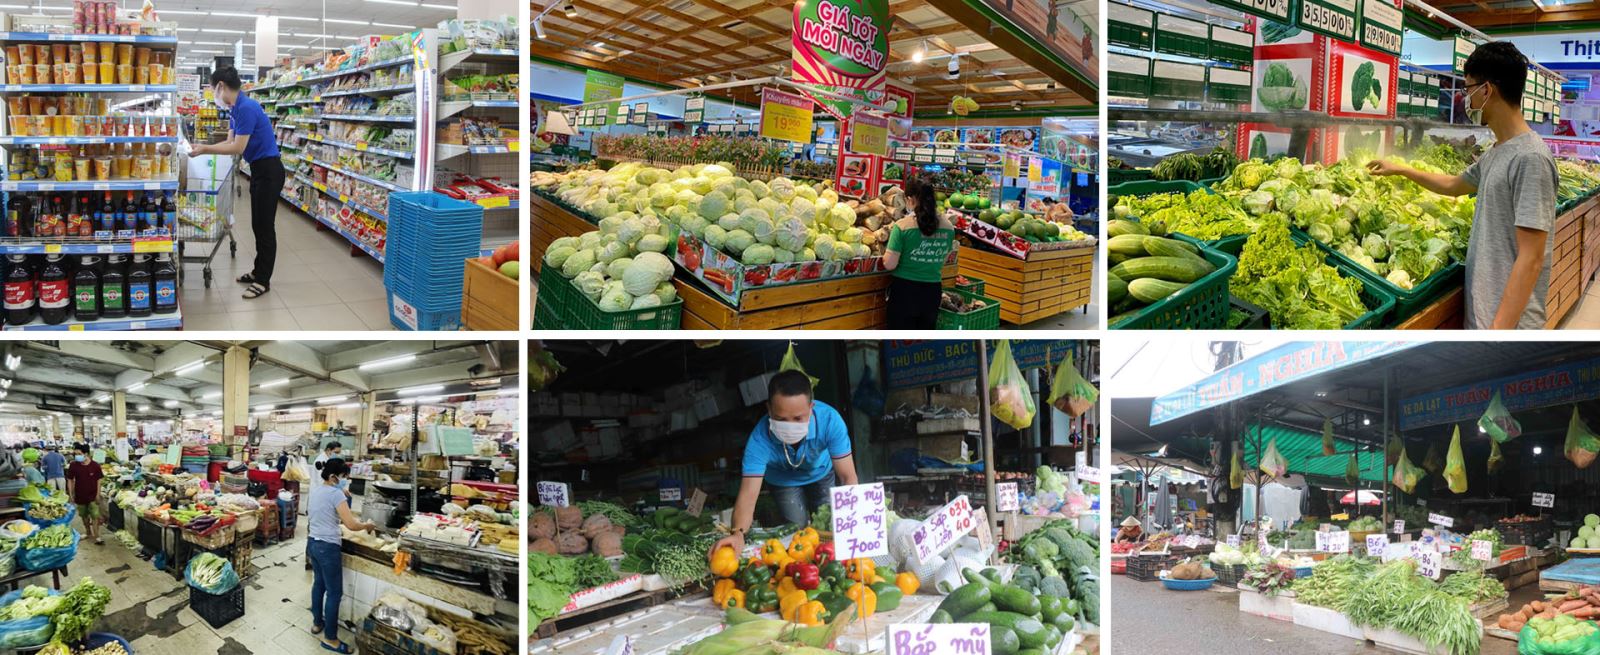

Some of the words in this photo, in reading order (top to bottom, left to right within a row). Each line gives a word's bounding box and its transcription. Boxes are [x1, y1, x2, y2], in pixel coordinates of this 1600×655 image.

[818, 1, 850, 33] GIÁ
[851, 15, 878, 45] TỐT
[1304, 4, 1345, 30] 35.500
[802, 18, 839, 53] MỖI
[840, 37, 884, 71] NGÀY
[1366, 26, 1395, 46] 29.900
[1561, 40, 1600, 60] Thịt
[766, 92, 789, 105] Khuyến
[945, 342, 968, 358] BẠC
[1200, 371, 1245, 402] TUẤN
[1505, 371, 1573, 396] NGHĨA
[834, 487, 858, 510] Bắp
[864, 484, 884, 505] mỹ
[949, 499, 968, 518] 034
[835, 511, 858, 534] Bắp
[863, 508, 884, 530] mỹ
[956, 520, 970, 532] 40
[894, 624, 937, 655] Bắp
[950, 627, 987, 655] mỹ
